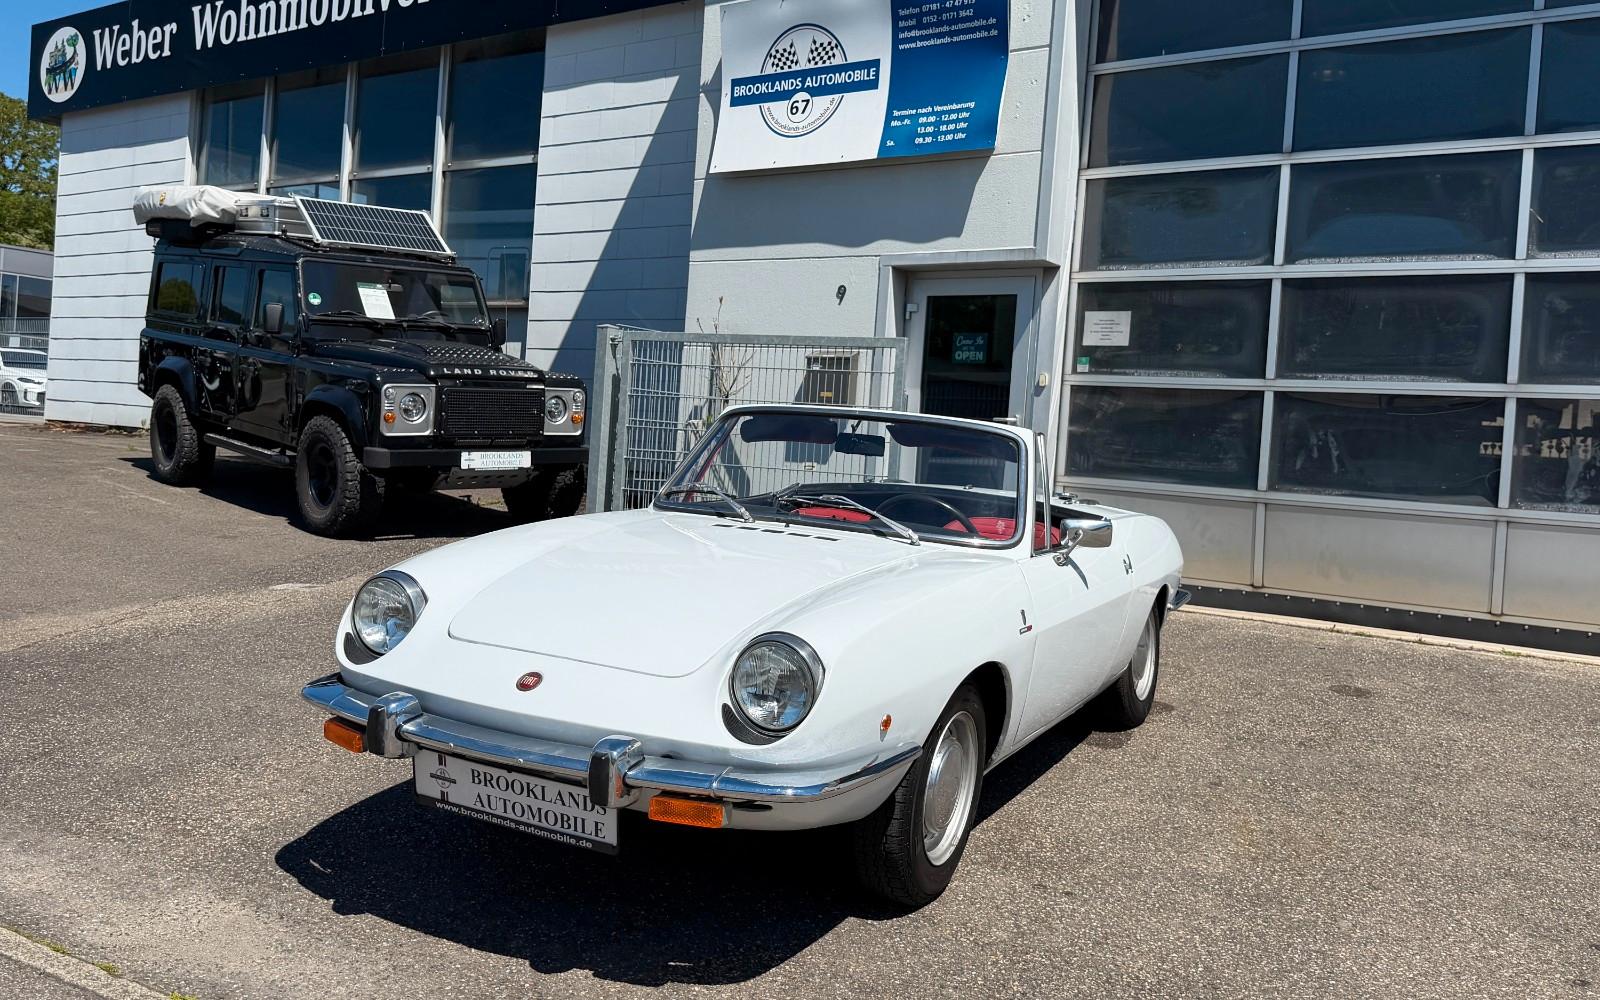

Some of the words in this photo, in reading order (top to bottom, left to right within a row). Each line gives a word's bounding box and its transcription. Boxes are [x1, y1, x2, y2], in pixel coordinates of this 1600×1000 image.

[898, 7, 919, 16] Telefon
[921, 3, 940, 12] 07181
[945, 0, 954, 8] 47
[898, 18, 916, 27] Mobil
[922, 14, 938, 24] 0152
[942, 11, 957, 21] 0171
[93, 19, 178, 72] Weber
[191, 0, 431, 50] Wohnmob
[898, 17, 997, 39] info@brooklands-automobile.de
[898, 28, 998, 50] www.brooklands-automobile.de
[734, 79, 801, 97] BROOKLANDS
[804, 68, 876, 88] AUTOMOBILE
[790, 99, 810, 115] 67
[934, 101, 975, 112] Vereinbarung
[918, 115, 936, 124] 09.00
[941, 113, 958, 121] 12.00
[917, 126, 934, 134] 13.00
[939, 123, 956, 132] 18.00
[914, 137, 932, 145] 09.30
[937, 135, 954, 143] 13.00
[836, 284, 847, 306] 9
[954, 350, 984, 361] OPEN
[443, 367, 482, 375] LAND
[489, 369, 537, 377] ROVER
[520, 675, 539, 686] FIAT
[470, 767, 607, 817] BROOKLANDS
[473, 791, 606, 839] AUTOMOBILE
[435, 801, 593, 849] www.brooklands-automobile.de
